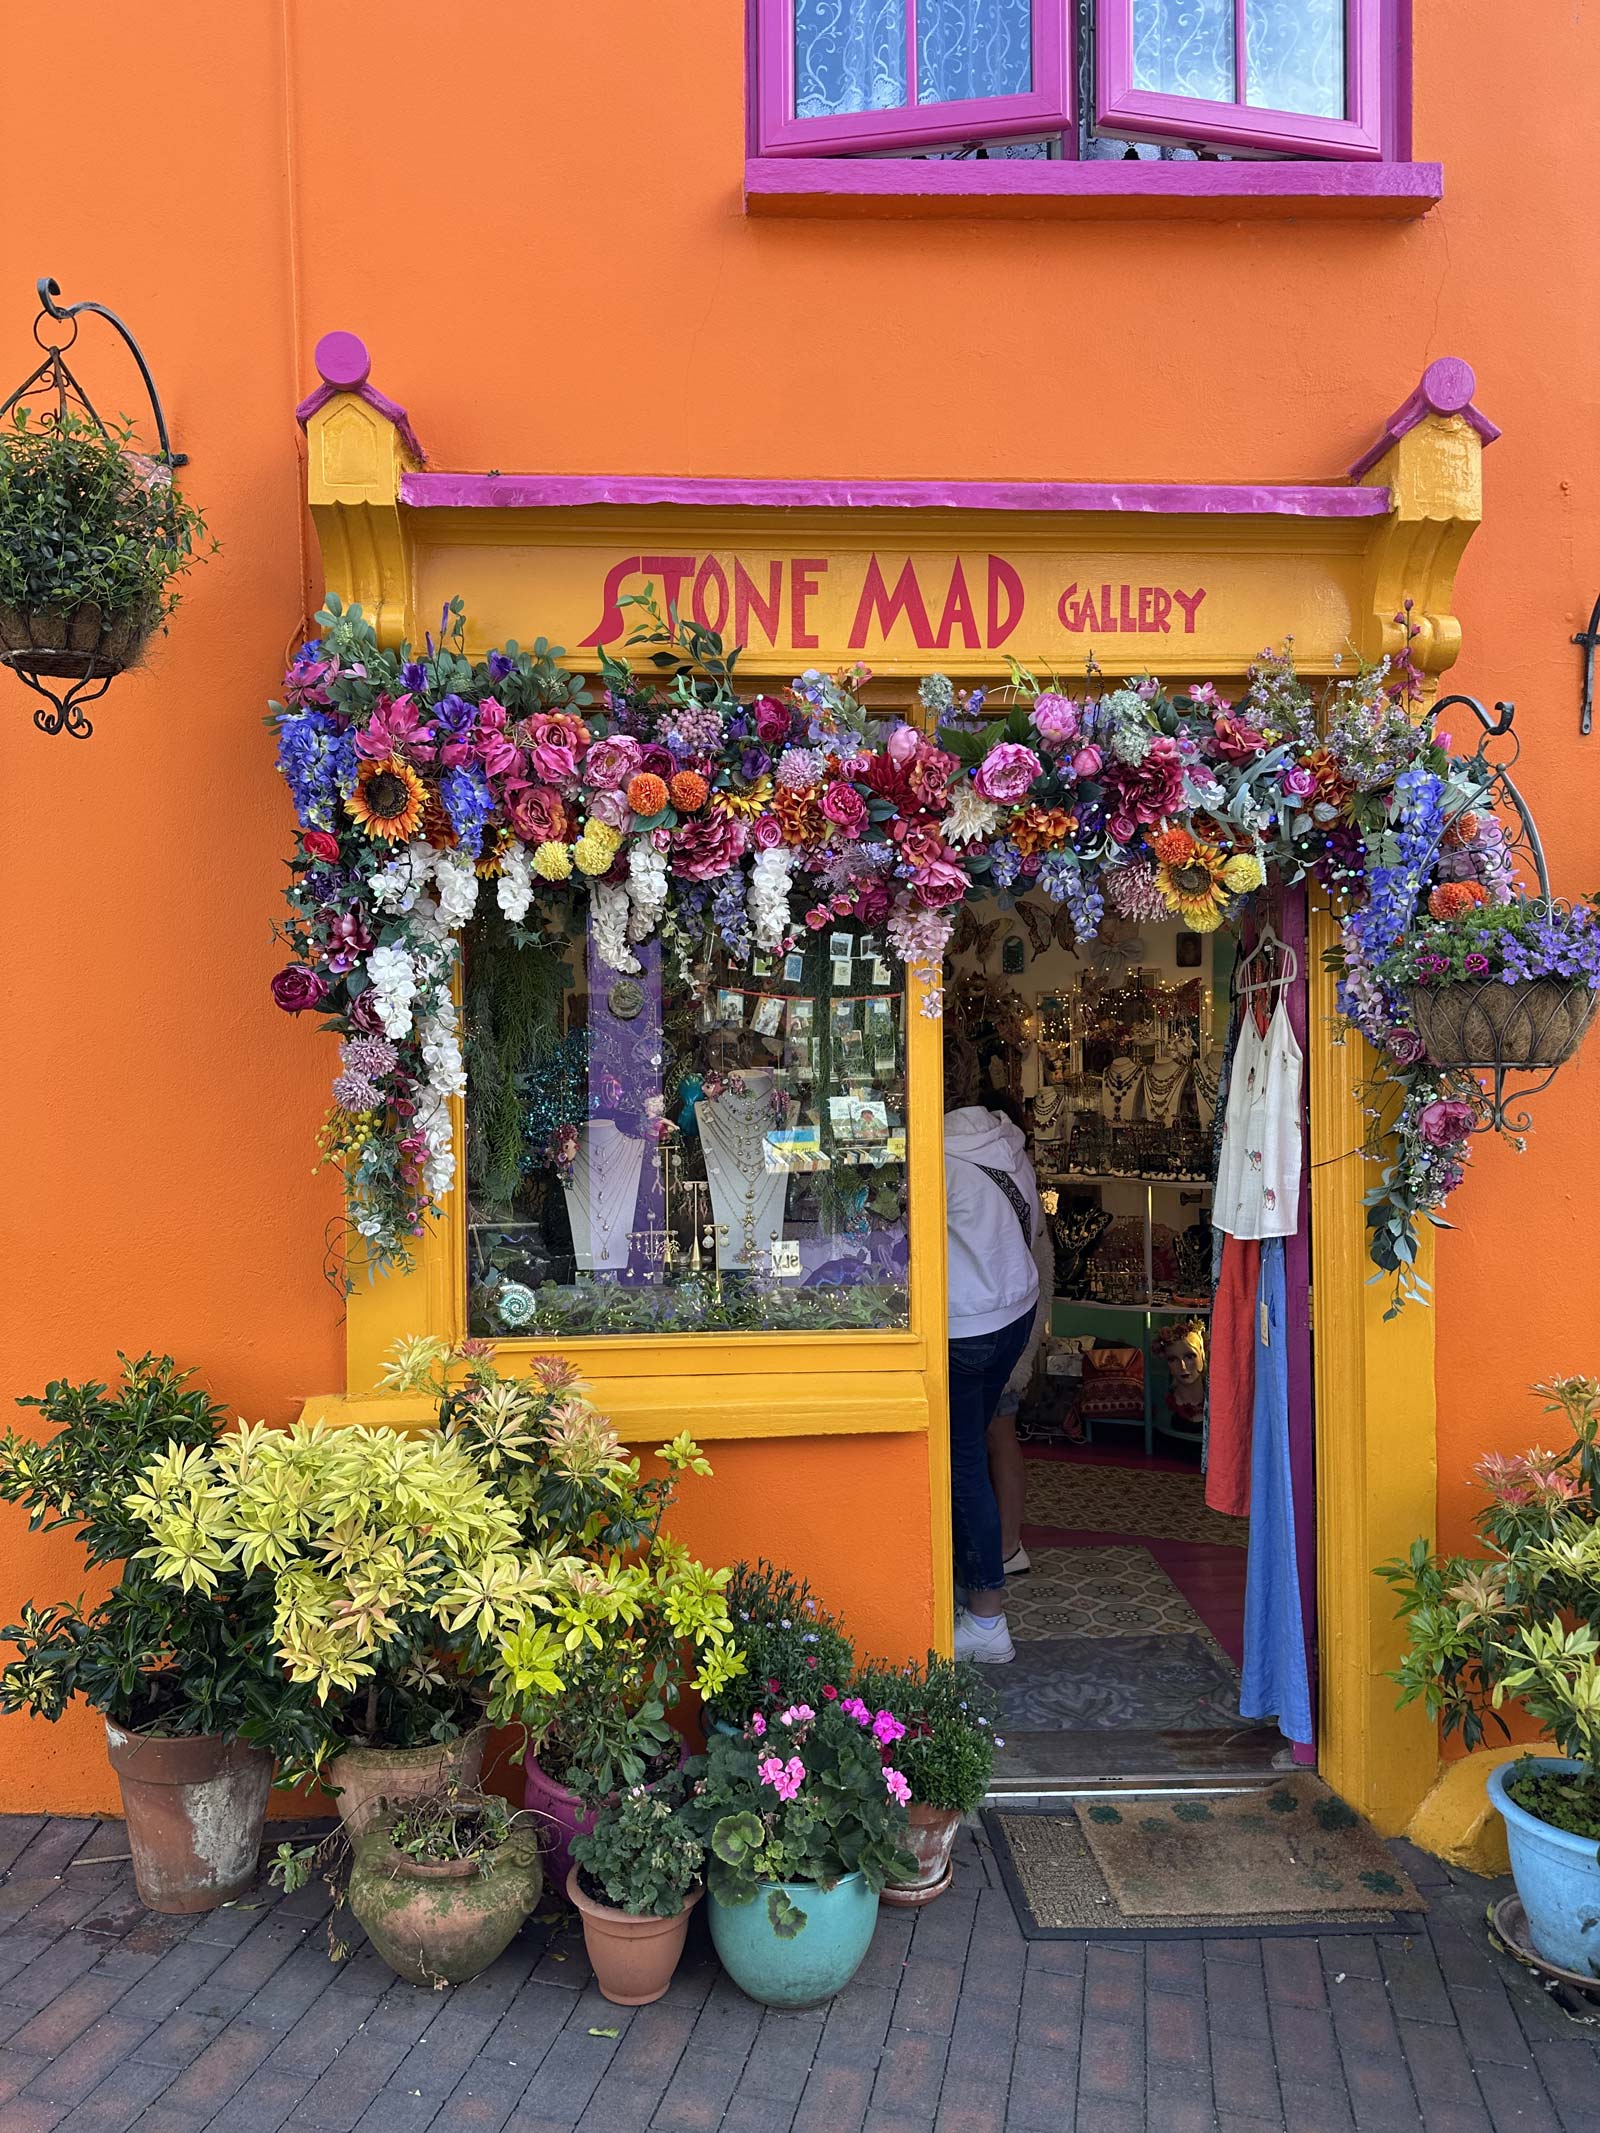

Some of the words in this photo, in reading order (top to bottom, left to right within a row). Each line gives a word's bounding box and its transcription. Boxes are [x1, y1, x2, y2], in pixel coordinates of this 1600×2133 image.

[579, 554, 828, 649] STONE
[848, 553, 1025, 649] MAD
[1058, 582, 1207, 634] GALLERY
